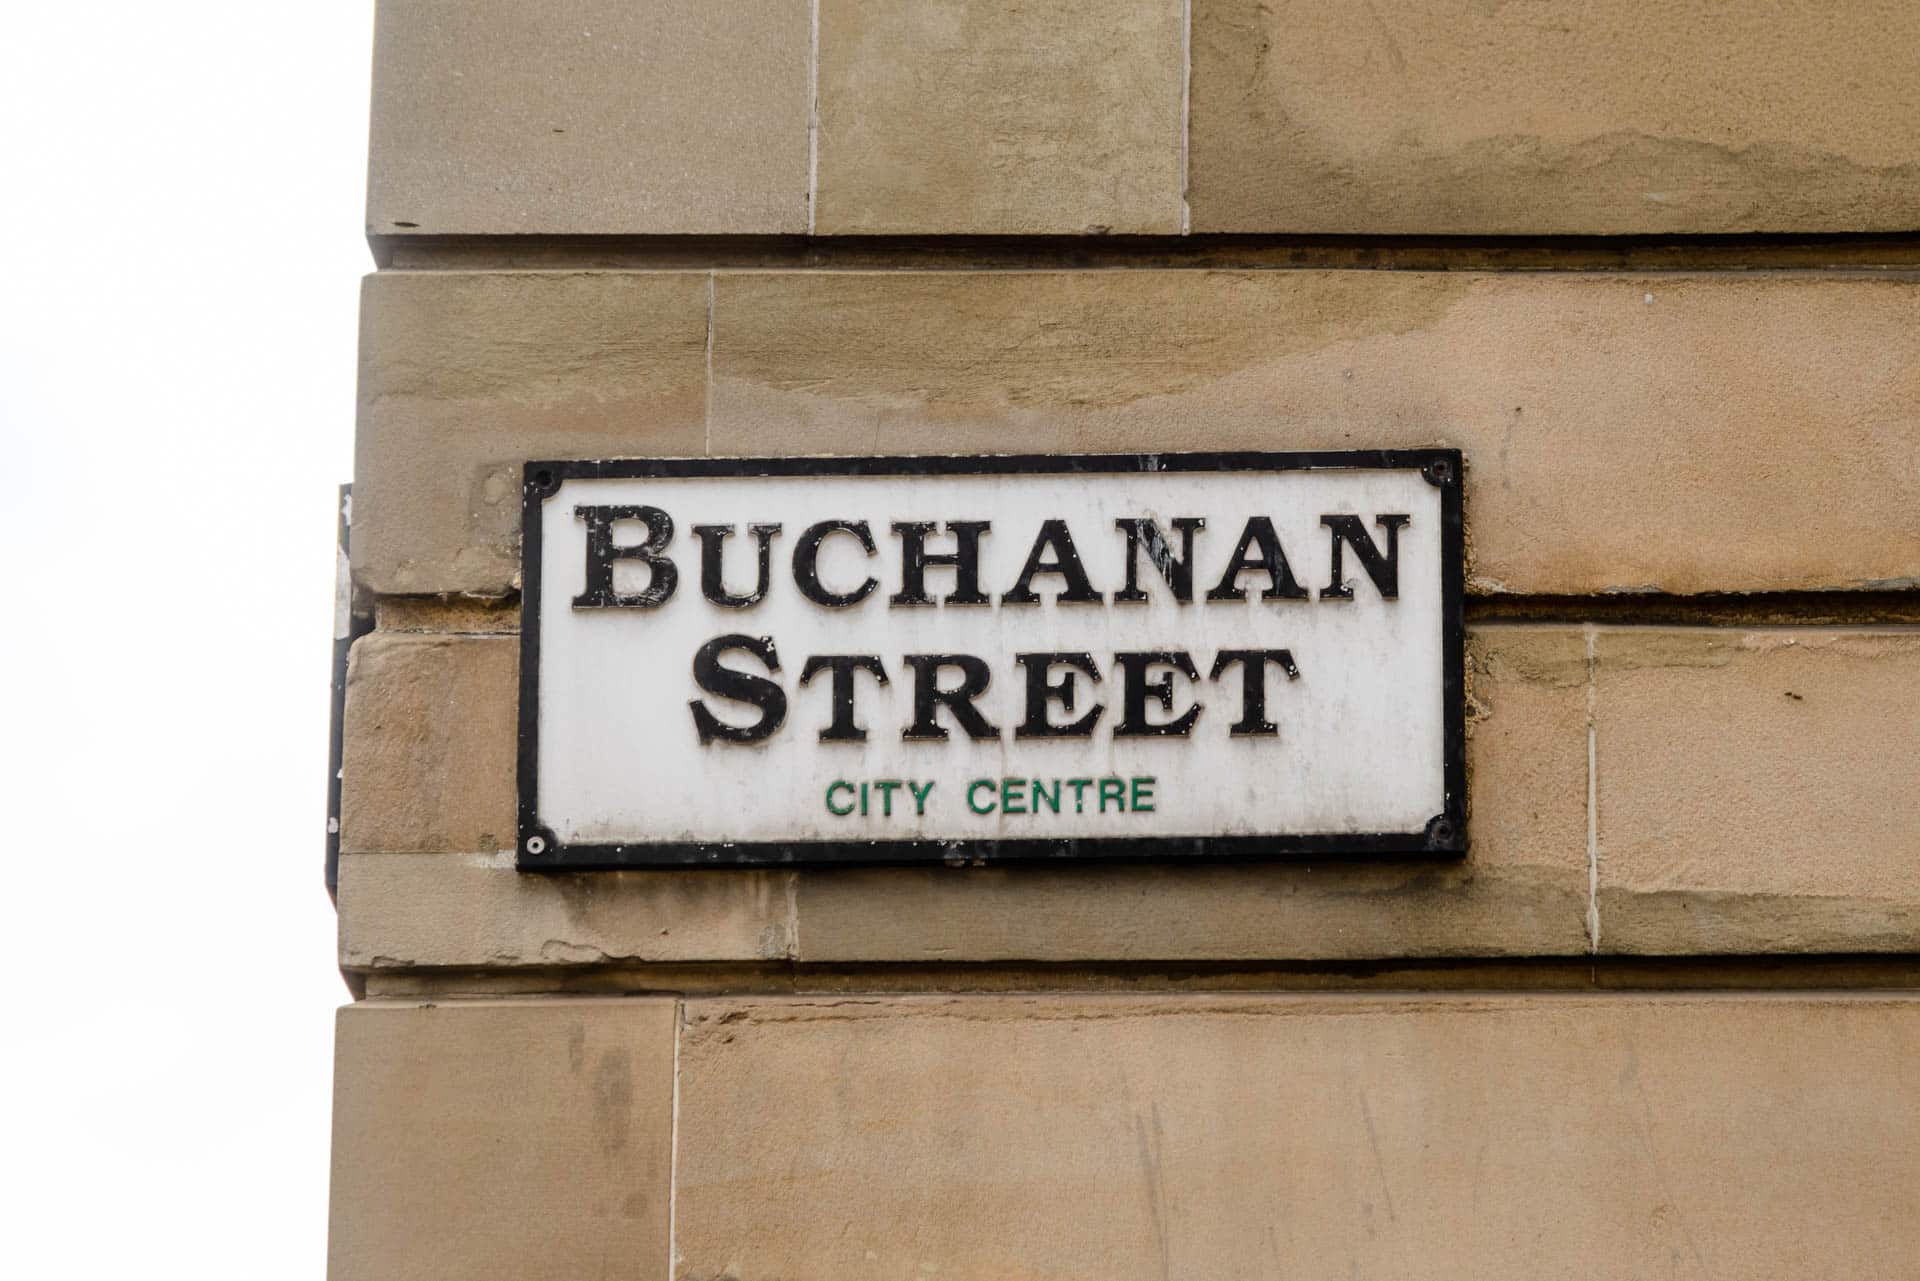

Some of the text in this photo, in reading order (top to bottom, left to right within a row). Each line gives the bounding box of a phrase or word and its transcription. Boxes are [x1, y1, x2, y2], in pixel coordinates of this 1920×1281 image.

[571, 505, 1411, 614] BUCHANAN
[688, 633, 1301, 748] STREET
[825, 777, 1156, 817] CITY CENTRE
